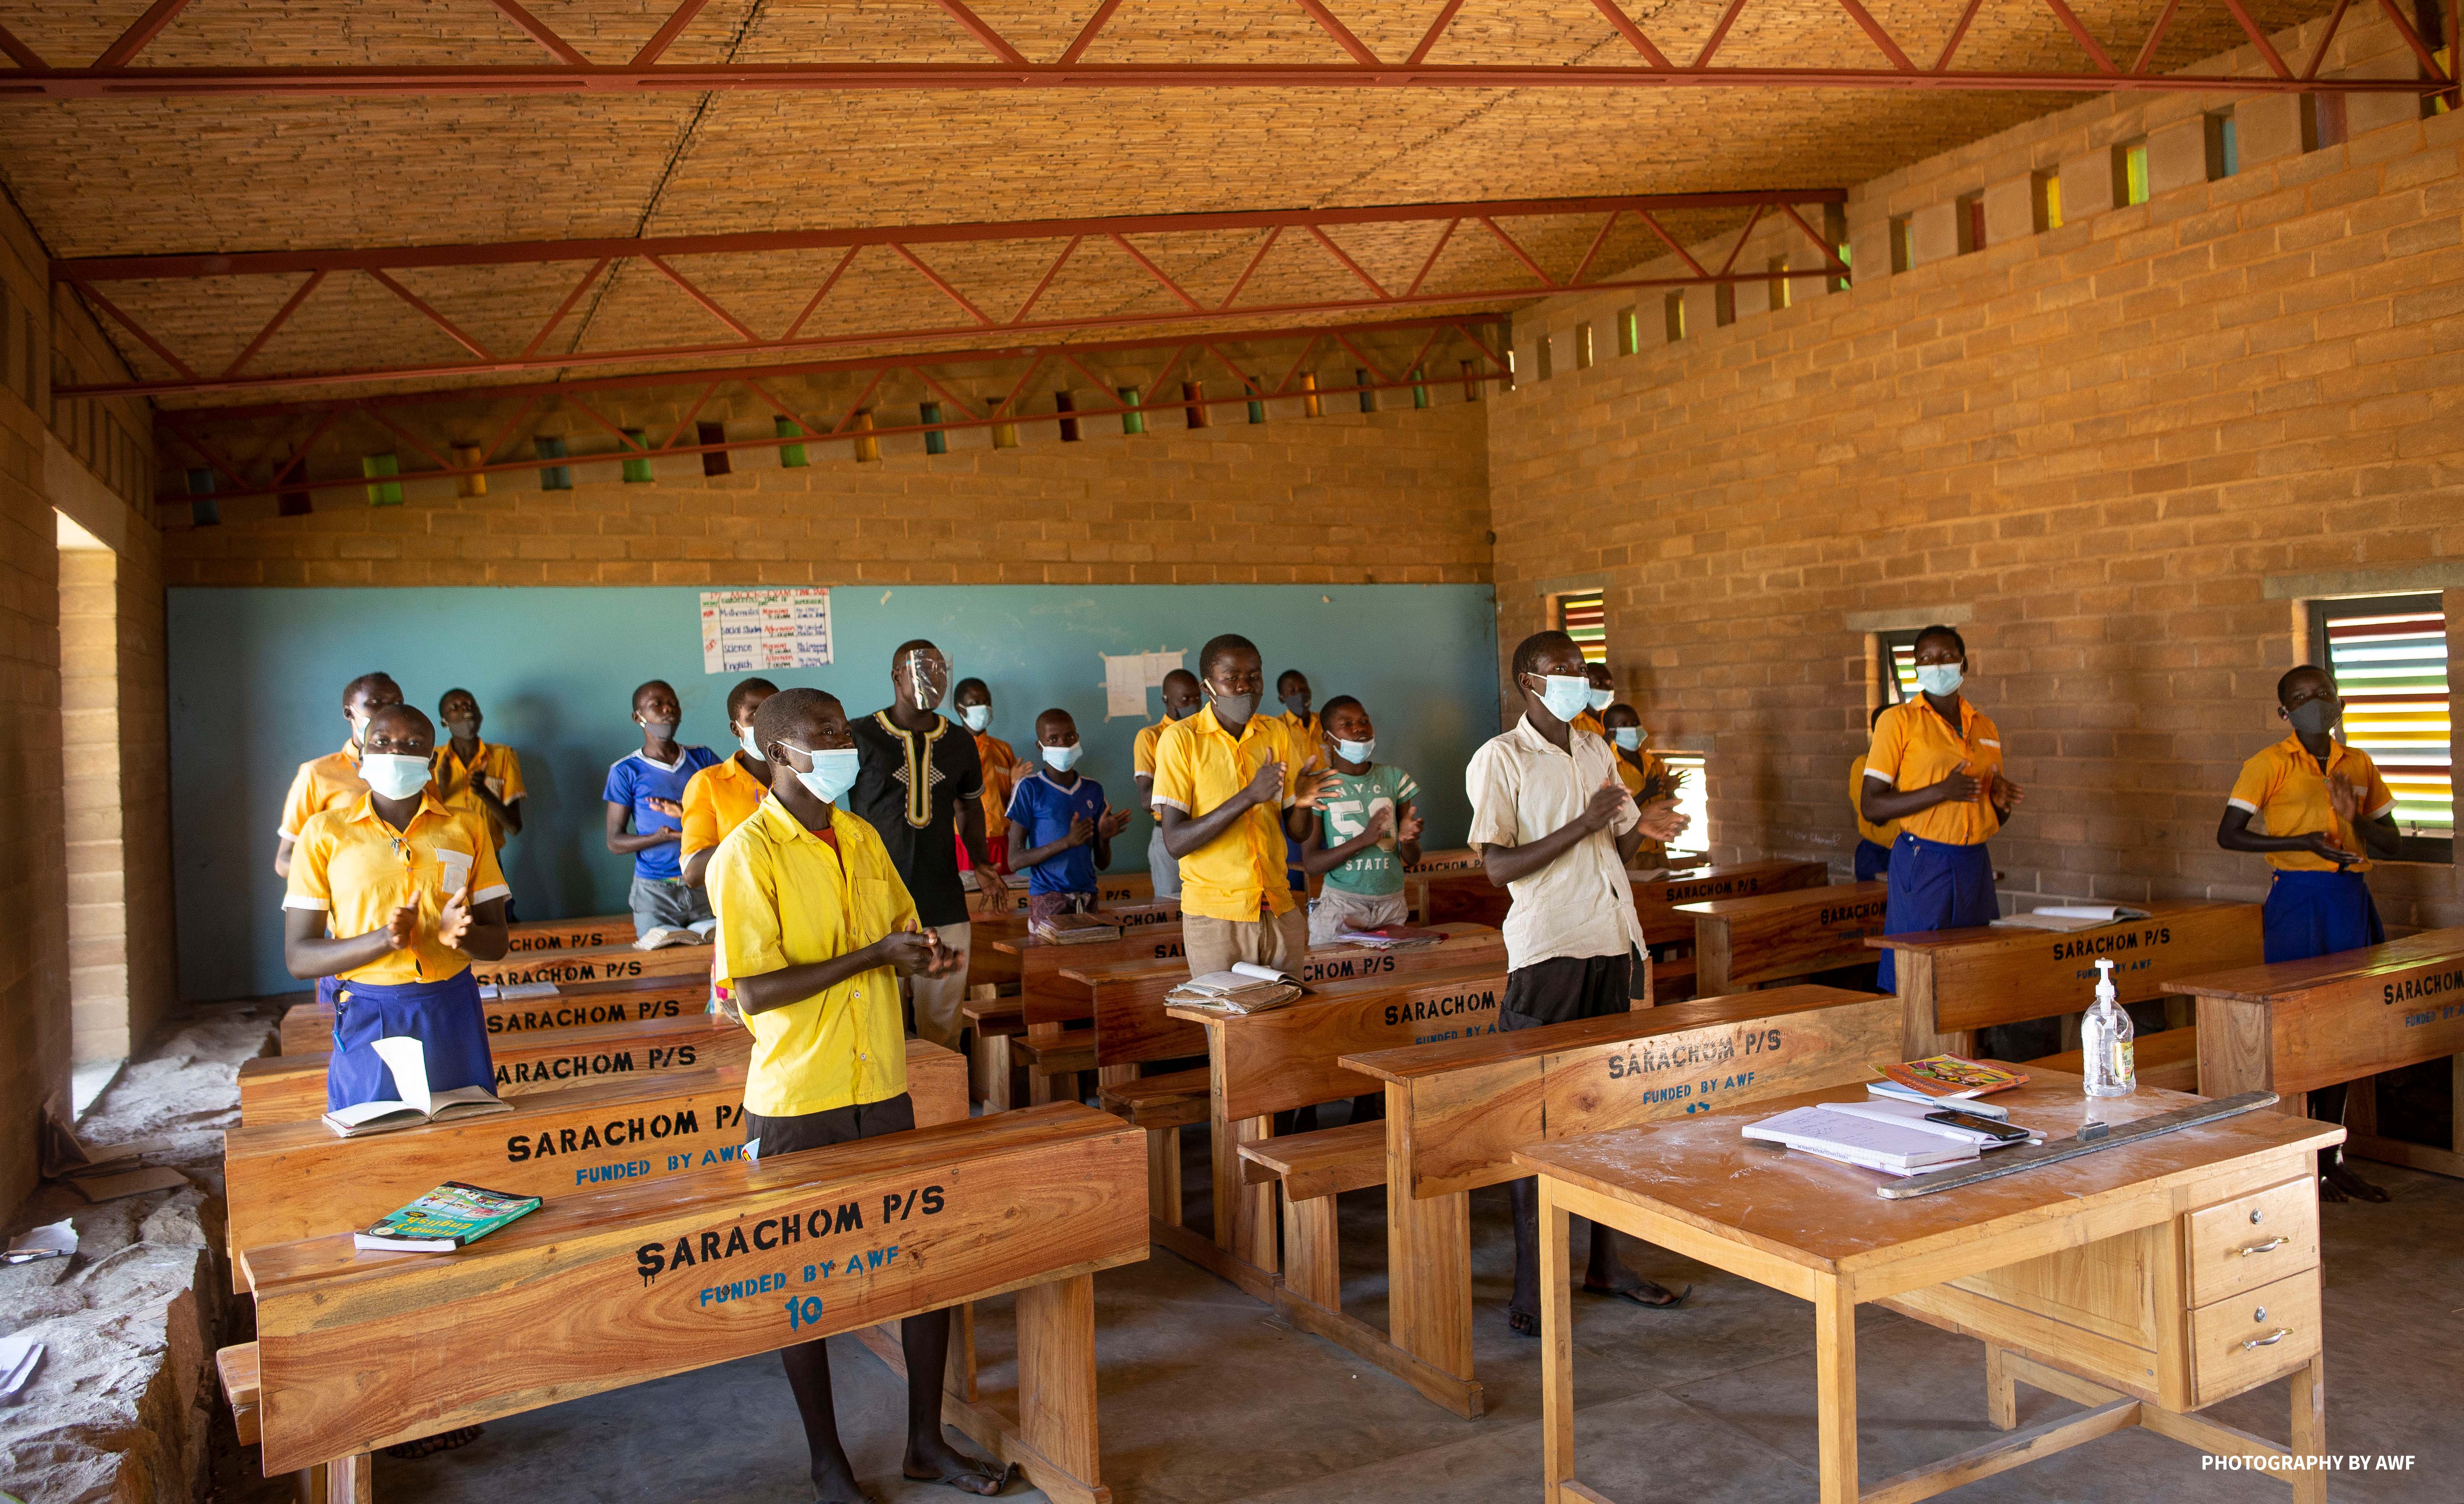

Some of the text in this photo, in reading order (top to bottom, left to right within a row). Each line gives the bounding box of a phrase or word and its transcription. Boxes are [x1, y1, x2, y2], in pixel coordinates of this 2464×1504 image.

[1345, 857, 1389, 871] STATE
[1106, 889, 1131, 901] P/S
[1666, 878, 1757, 902] SARACHOM P/S
[1123, 911, 1168, 927] CHOM
[1821, 900, 1887, 925] SARACHOM
[510, 933, 602, 951] CHOM P/S
[2054, 928, 2170, 960] SARACHOM P/S
[477, 961, 642, 986] SARACHOM P/S
[1304, 956, 1395, 982] CHOM P/S
[2115, 963, 2126, 974] BY
[2384, 970, 2464, 1005] SARACHOM
[486, 1000, 680, 1033] SARACHOM P/S
[1385, 990, 1496, 1026] SARACHOM
[2405, 1011, 2436, 1028] FUNDED
[1466, 1025, 1481, 1038] BY
[495, 1045, 697, 1086] ARACHOM P/S
[1609, 1029, 1781, 1079] SARACHOM P/S
[1643, 1071, 1755, 1105] FUNDED BY AWF
[507, 1102, 743, 1163] SARACHOM P/
[576, 1159, 651, 1186] FUNDED
[668, 1153, 692, 1171] BY
[393, 1223, 460, 1236] Primary
[407, 1217, 474, 1230] English
[489, 1221, 500, 1230] English
[636, 1185, 945, 1282] SARACHOM P/S
[700, 1245, 899, 1308] FUNDED BY AWF
[785, 1295, 823, 1332] 10
